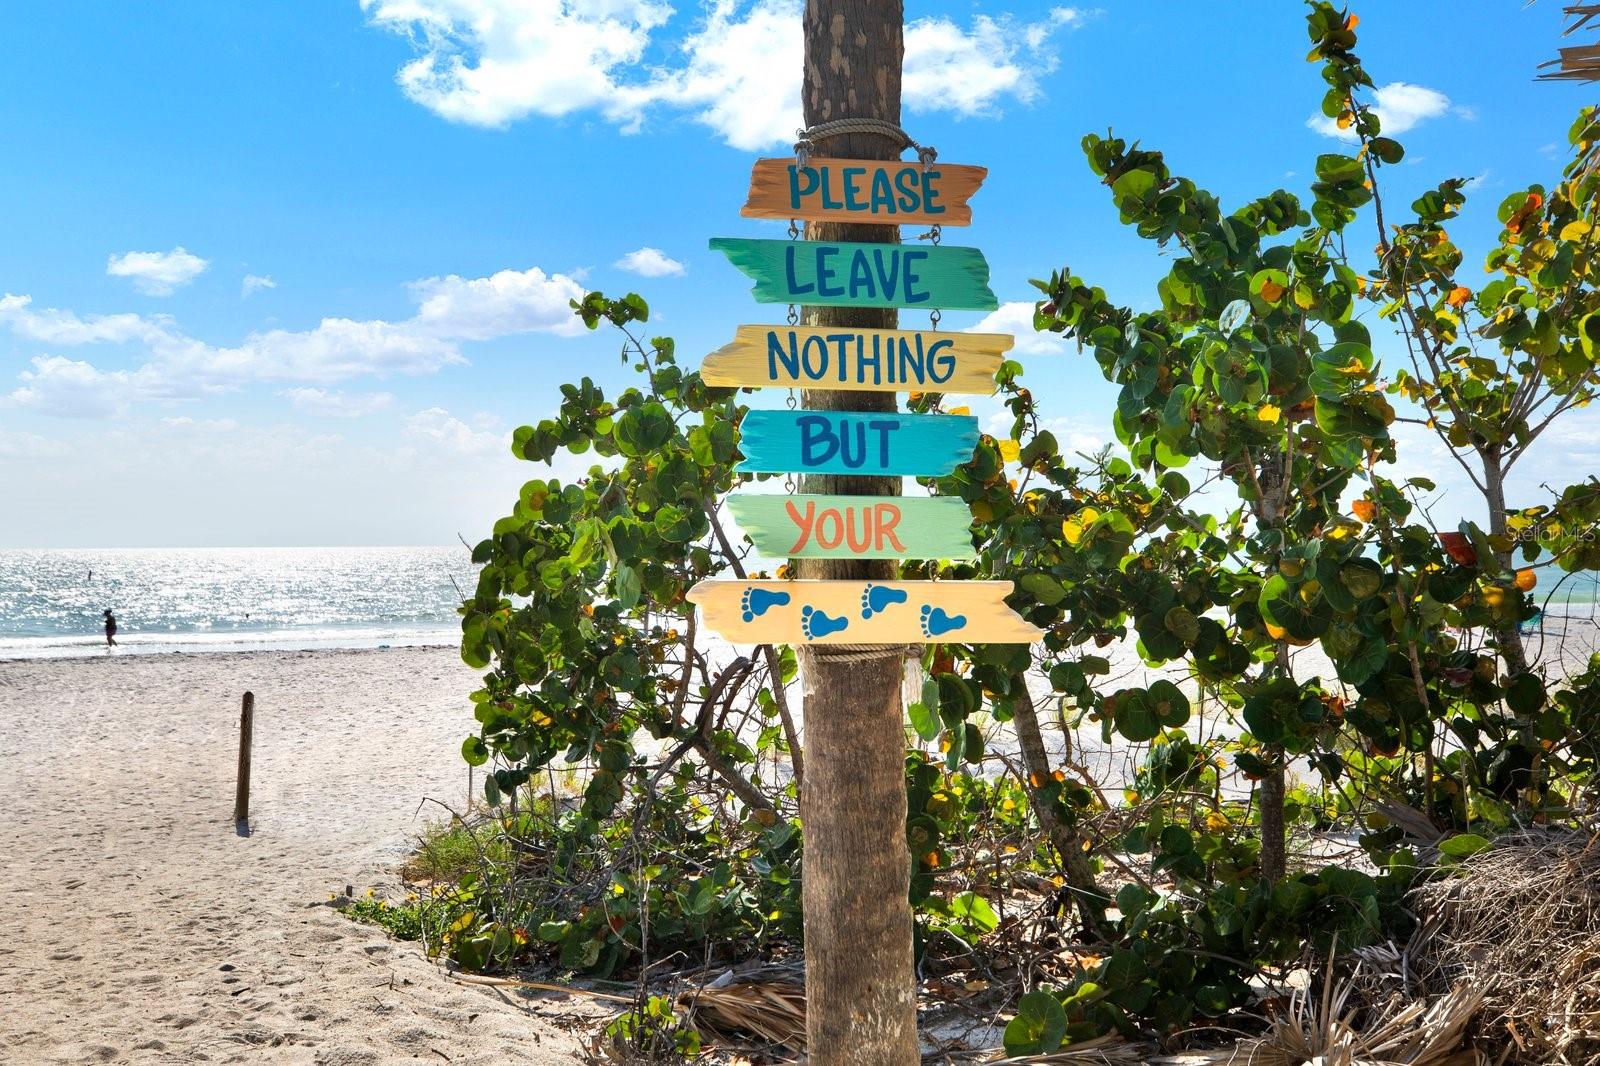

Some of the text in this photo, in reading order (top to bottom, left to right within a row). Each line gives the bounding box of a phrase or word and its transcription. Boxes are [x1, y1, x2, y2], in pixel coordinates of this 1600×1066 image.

[787, 165, 945, 214] PLEASE
[786, 246, 930, 303] LEAVE
[767, 331, 956, 385] NOTHING
[796, 415, 900, 469] BUT
[785, 500, 907, 554] YOUR
